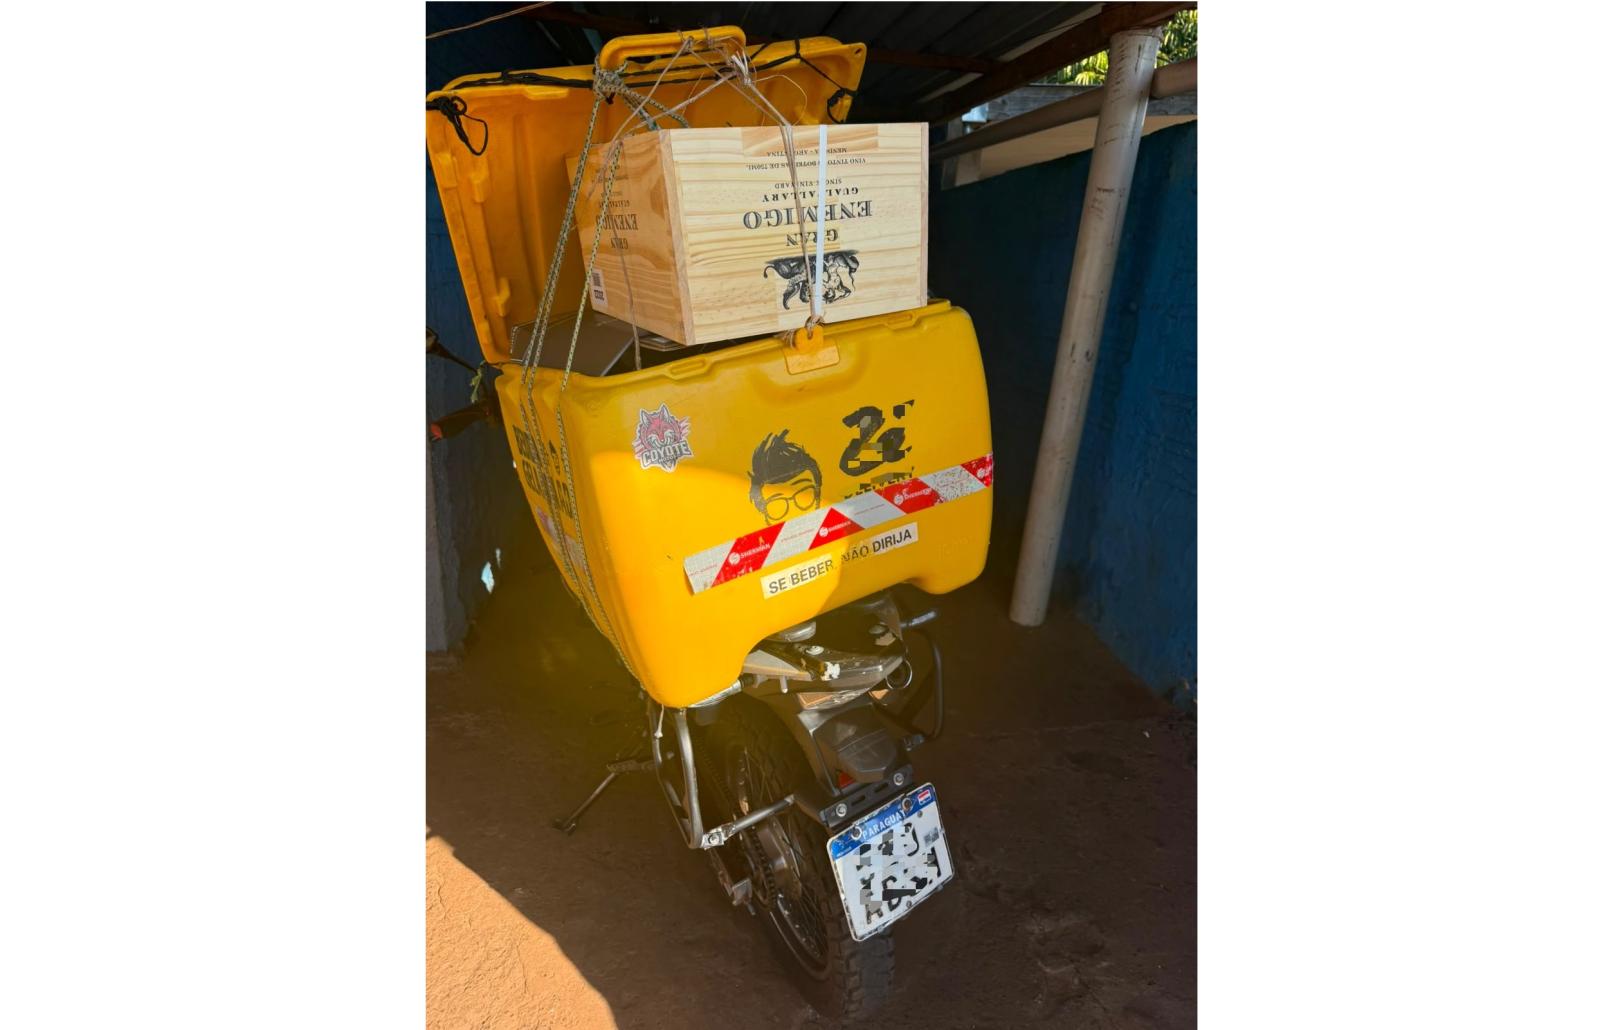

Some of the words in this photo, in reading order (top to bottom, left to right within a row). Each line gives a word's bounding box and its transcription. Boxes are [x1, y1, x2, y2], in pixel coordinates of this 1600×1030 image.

[766, 149, 809, 157] ARGTINA
[815, 147, 847, 155] MENDA
[827, 158, 848, 166] TINTO
[849, 157, 866, 165] VINO
[761, 187, 859, 203] GUALALLARY
[742, 200, 873, 230] ENEMIGO
[785, 228, 839, 247] GRAN
[642, 441, 691, 466] COYOTE
[740, 543, 771, 559] SHERMAN
[769, 577, 788, 594] SE
[841, 545, 869, 562] NÃO
[872, 529, 912, 554] DIRIJA
[861, 809, 906, 840] PARAGUAY
